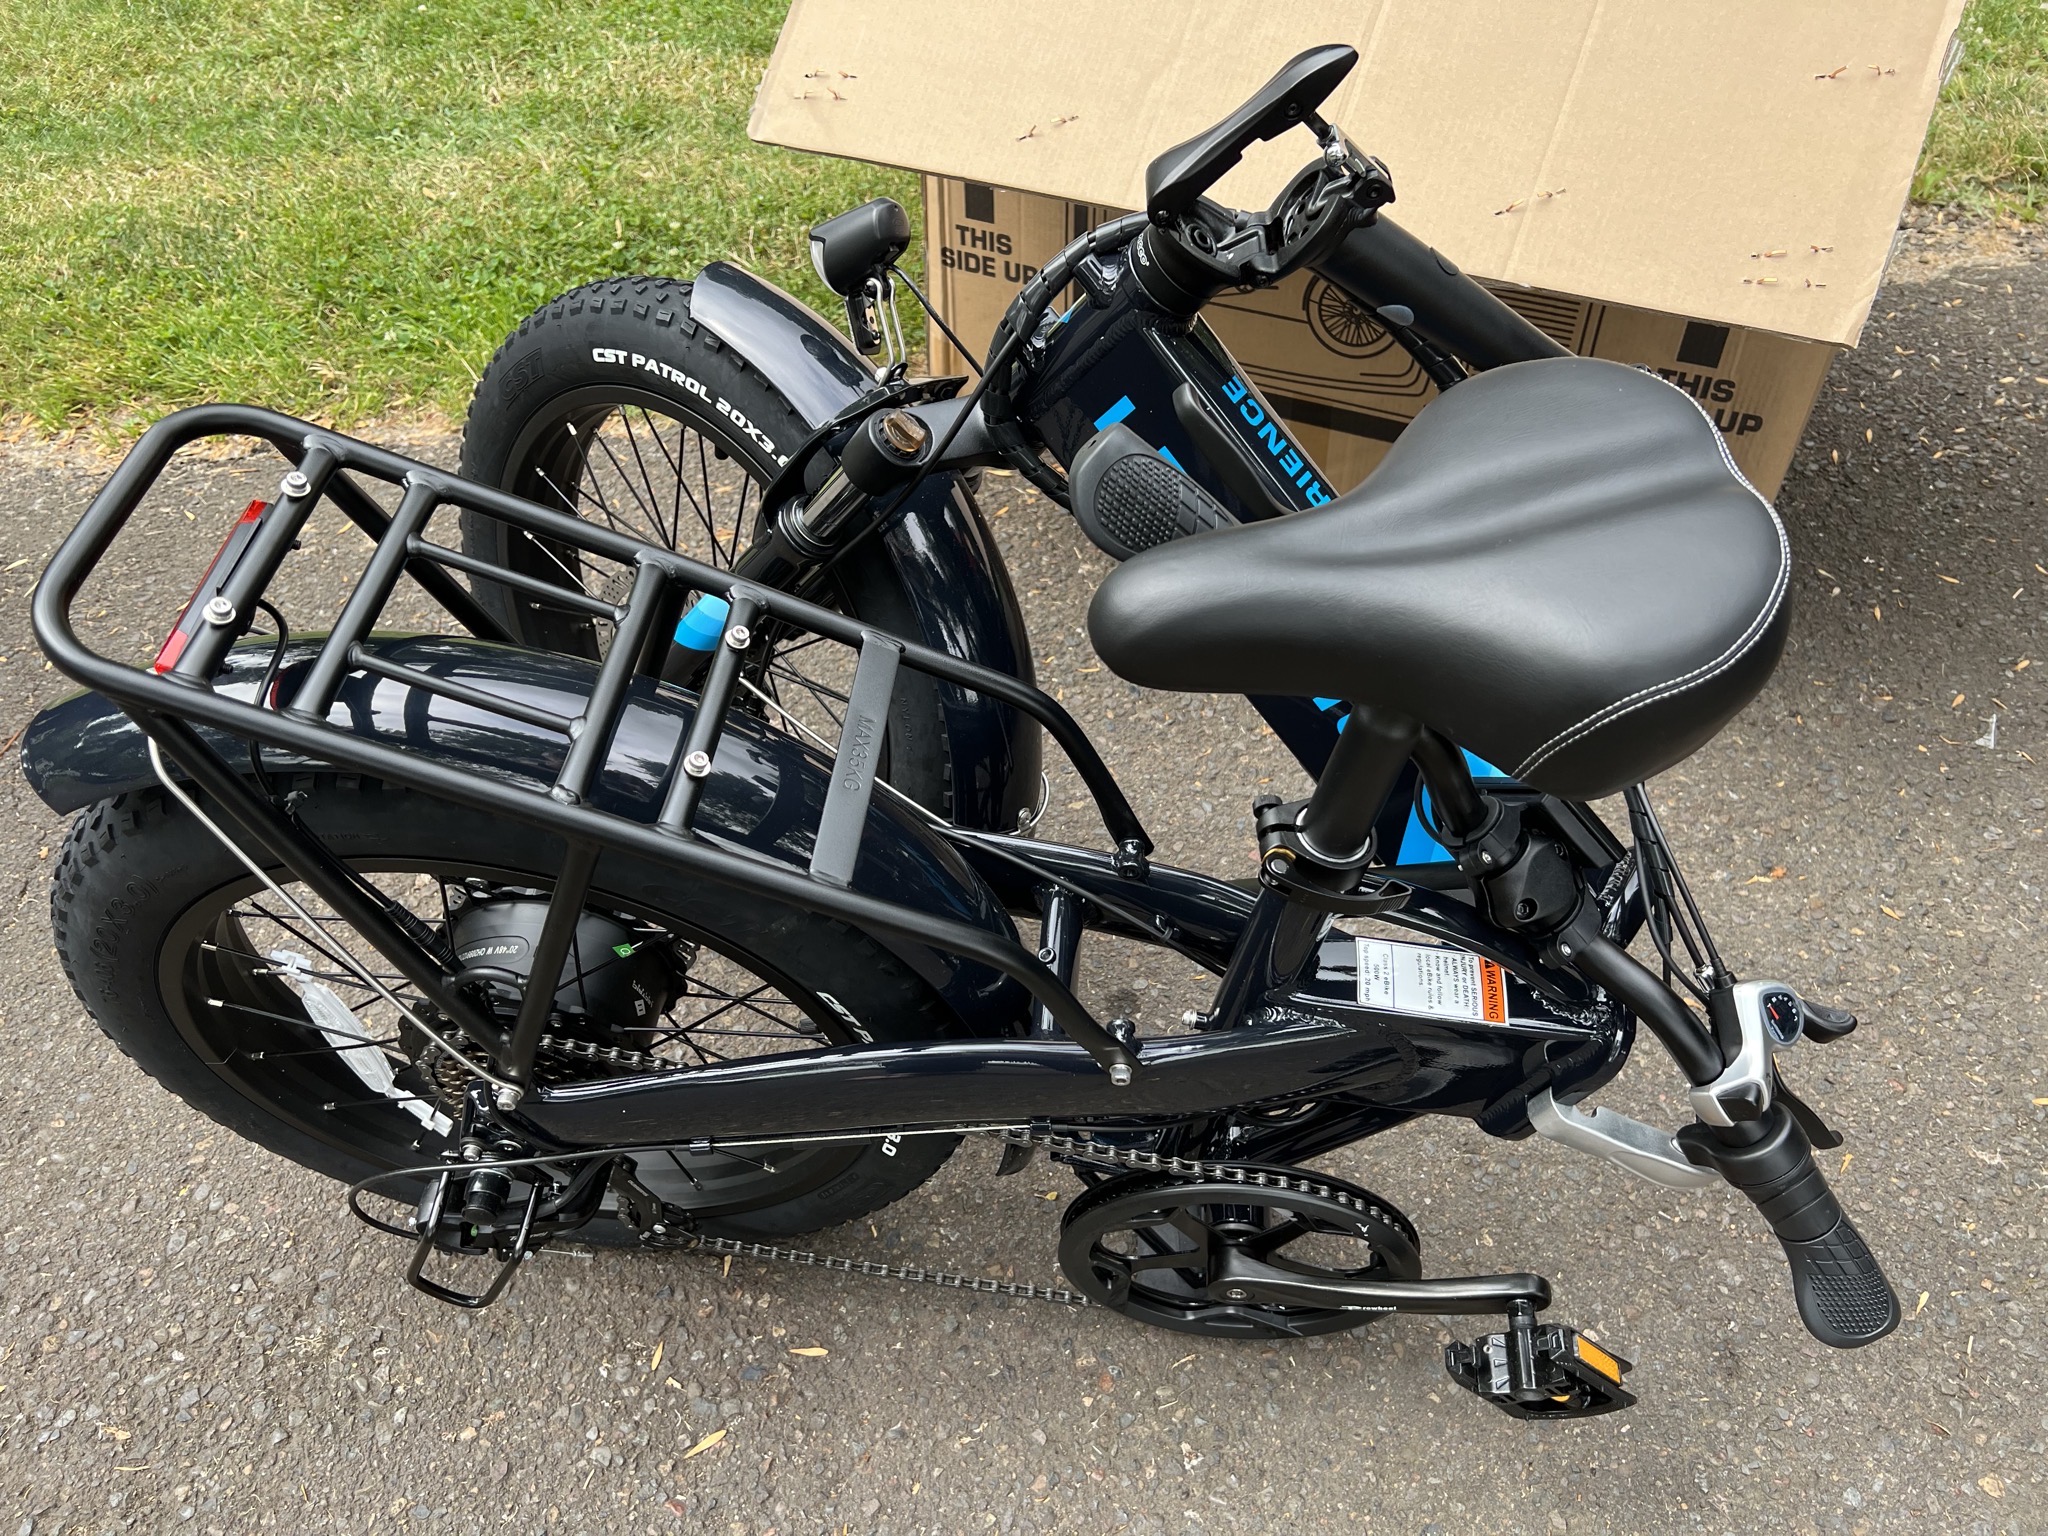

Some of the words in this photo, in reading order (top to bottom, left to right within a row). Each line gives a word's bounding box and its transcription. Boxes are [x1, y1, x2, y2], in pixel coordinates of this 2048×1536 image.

[955, 224, 1012, 256] THIS
[941, 246, 996, 278] SIDE
[1004, 260, 1040, 285] UP
[592, 348, 628, 364] CST
[631, 353, 712, 404] PATROL
[1714, 408, 1763, 436] UP
[1221, 375, 1331, 508] RIENCE
[844, 715, 876, 792] MAX35KG
[1451, 957, 1459, 983] ALWAYS
[1468, 956, 1475, 964] To
[1468, 964, 1476, 987] prevent
[1364, 977, 1371, 986] 20
[1486, 970, 1499, 1020] WARNING
[816, 991, 862, 1027] CST
